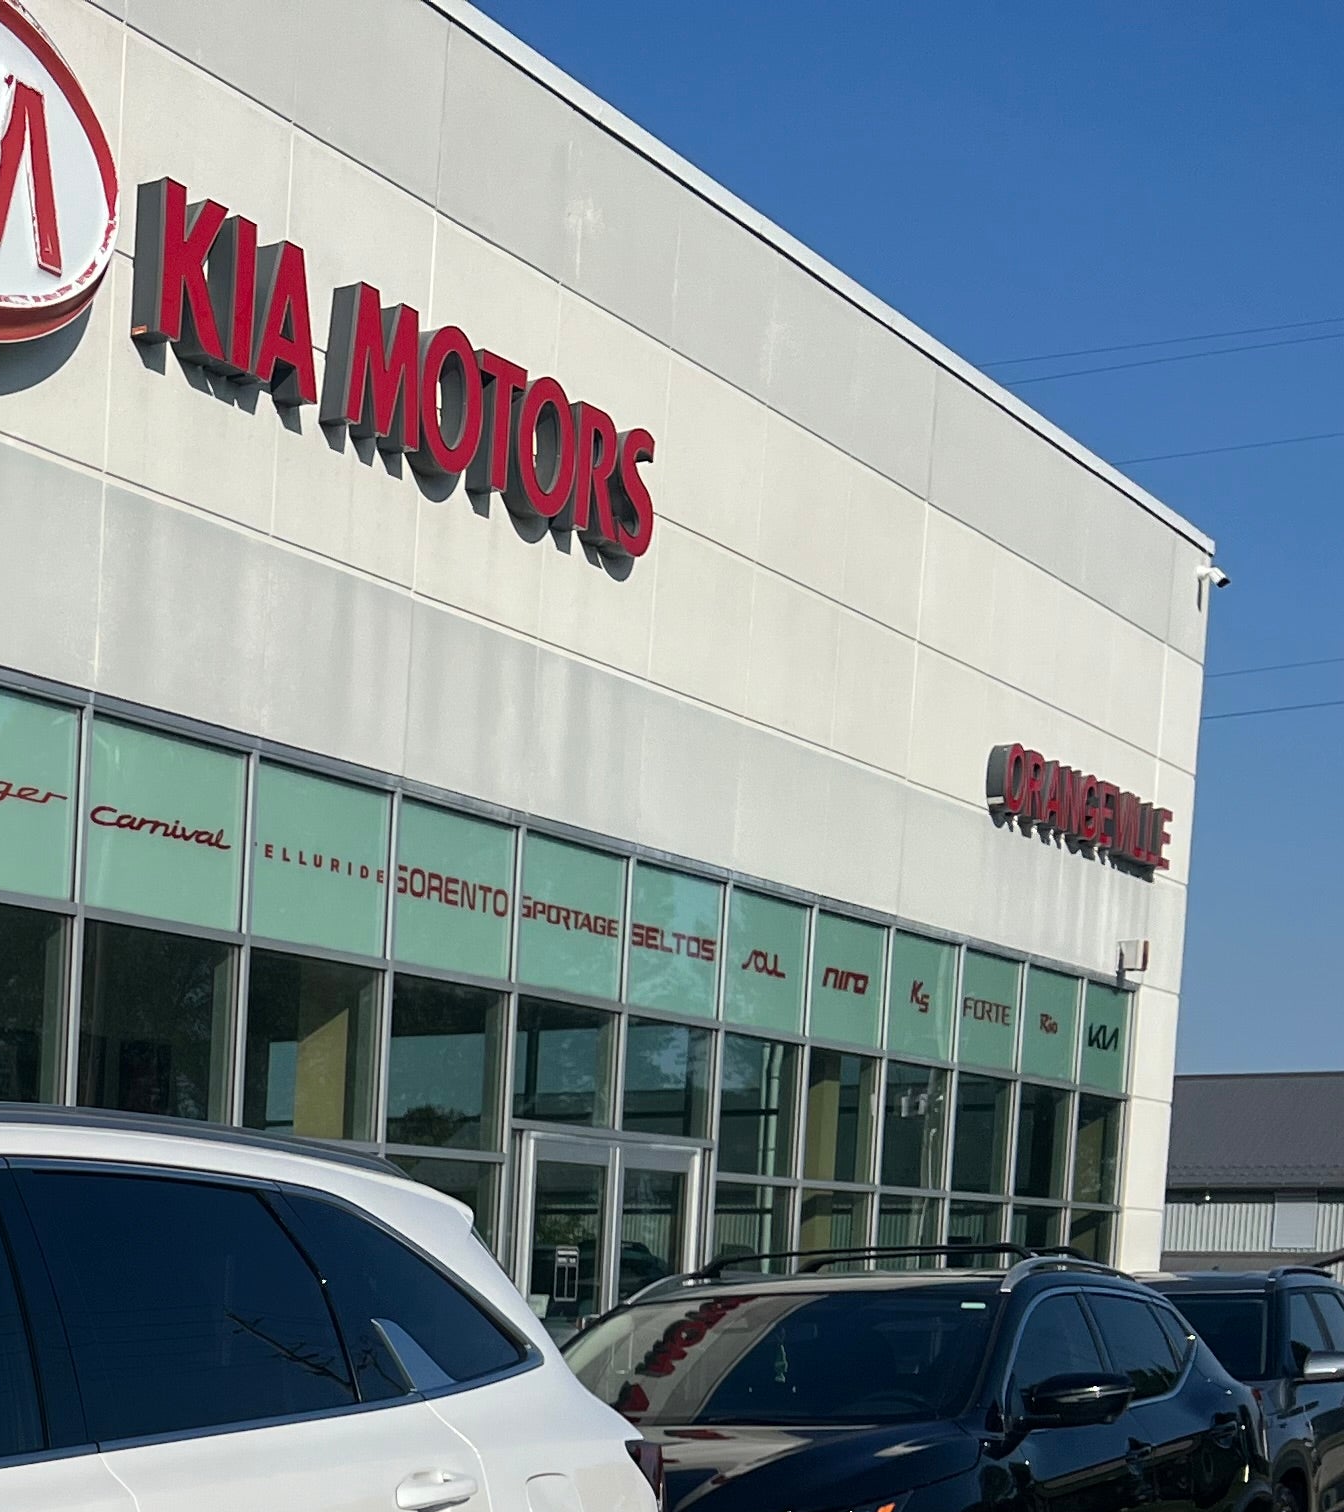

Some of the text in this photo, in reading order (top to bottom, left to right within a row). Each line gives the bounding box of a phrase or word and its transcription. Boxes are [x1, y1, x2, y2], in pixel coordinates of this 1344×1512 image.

[162, 176, 657, 559] KIA MOTORS
[89, 805, 232, 851] Carnival
[1002, 742, 1174, 871] ORANGEVILLE
[254, 841, 385, 884] ELLURIDE
[397, 864, 509, 917] SORENTO
[520, 895, 619, 938] SPORTAGE
[631, 923, 716, 962] SELTOS
[963, 996, 1011, 1027] FORTE
[1087, 1022, 1119, 1052] KIA
